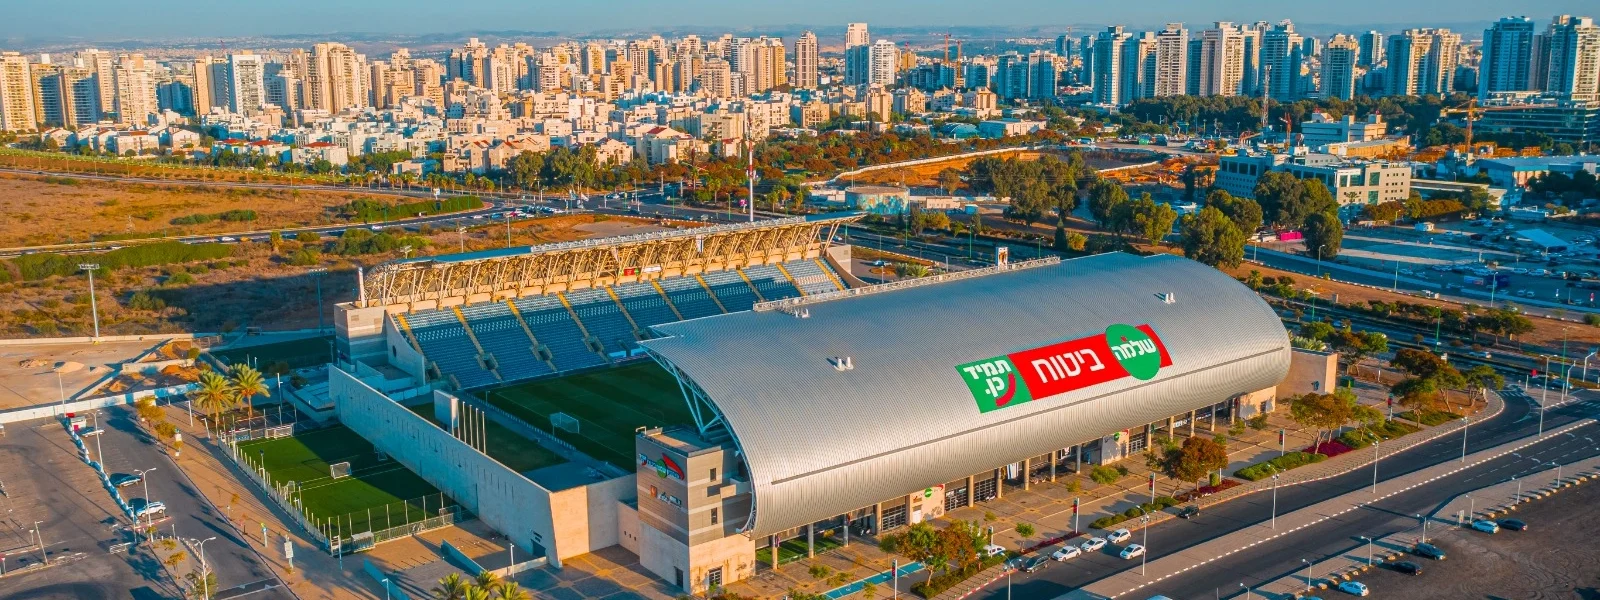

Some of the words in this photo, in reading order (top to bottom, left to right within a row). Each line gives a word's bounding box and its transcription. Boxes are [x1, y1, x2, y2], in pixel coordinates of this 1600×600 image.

[1111, 338, 1156, 360] שלמה
[963, 360, 1011, 379] תמיד
[1031, 349, 1105, 383] ביטוח
[985, 377, 1005, 397] כן.
